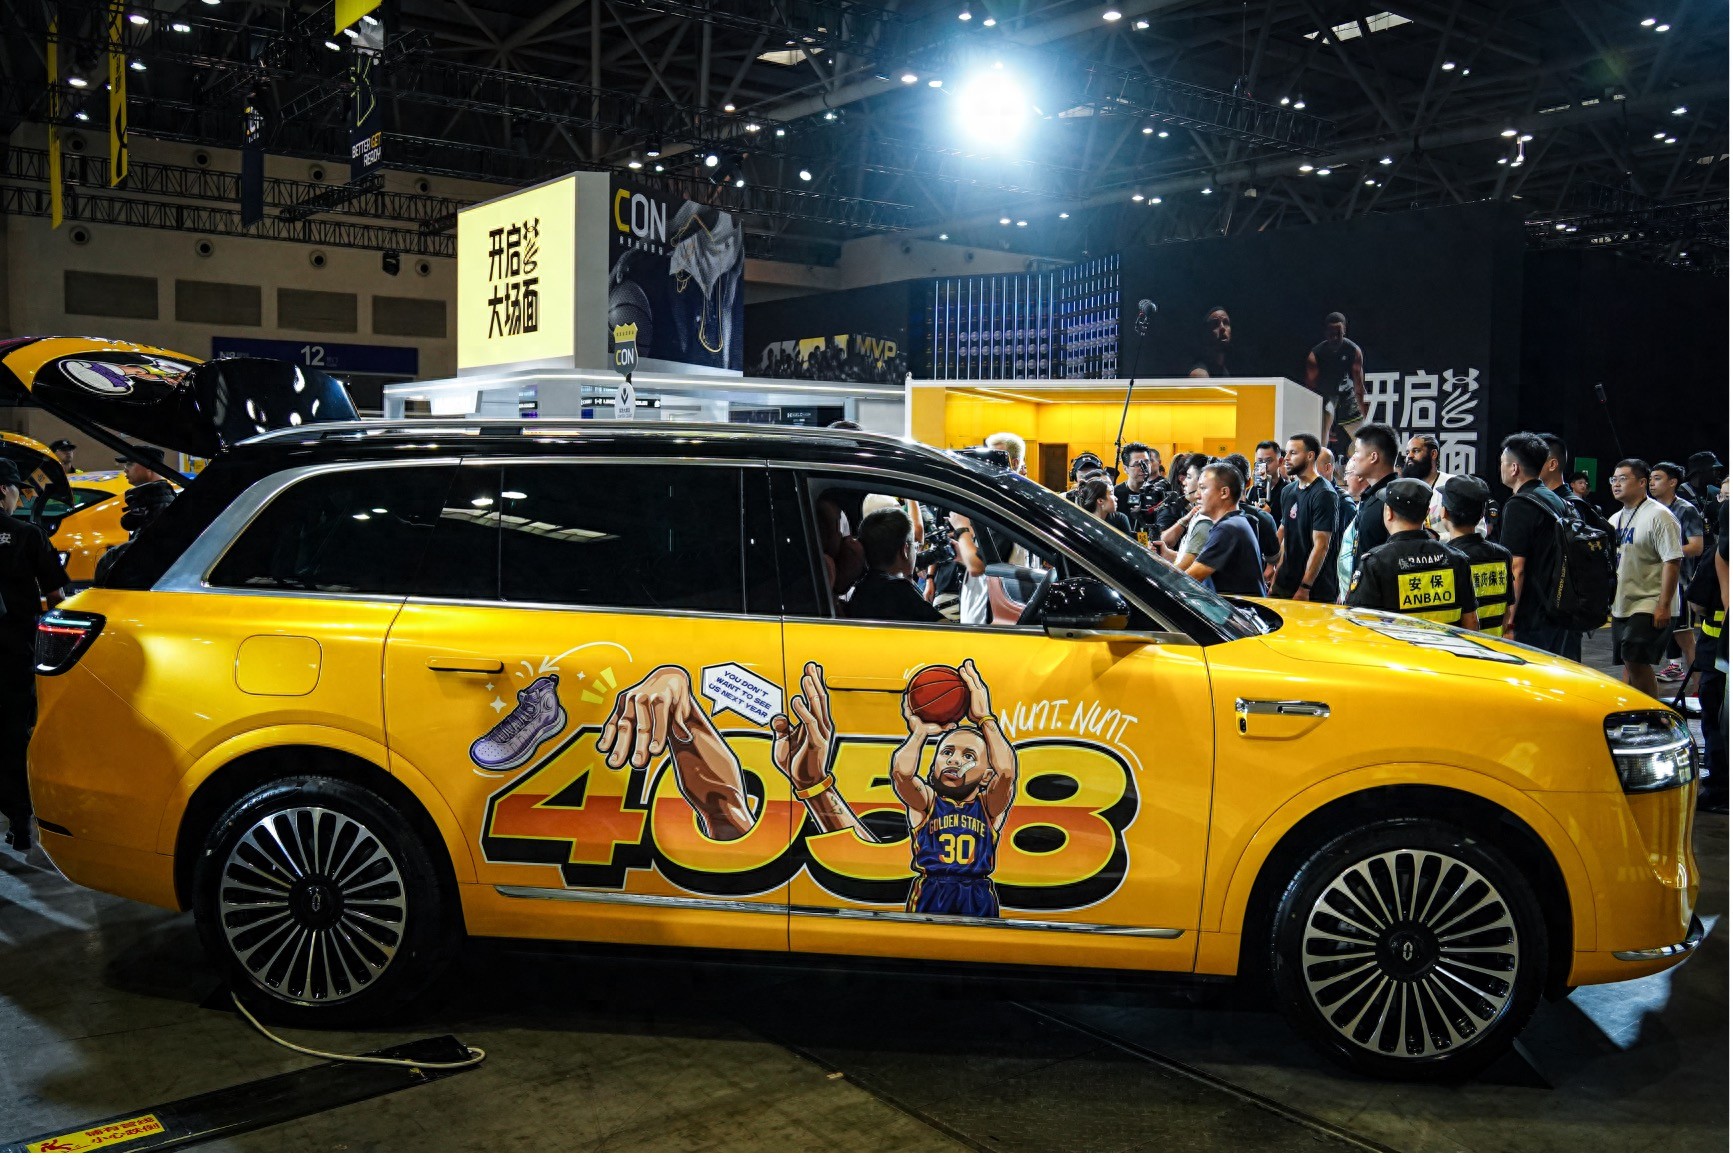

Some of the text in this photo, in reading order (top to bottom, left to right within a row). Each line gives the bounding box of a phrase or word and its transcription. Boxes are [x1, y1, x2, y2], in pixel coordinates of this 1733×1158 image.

[352, 131, 382, 159] BETTER GET
[364, 147, 381, 167] READY
[615, 188, 666, 243] CON
[489, 223, 521, 282] 开启
[488, 277, 539, 339] 大场面
[300, 345, 325, 366] 12
[615, 348, 634, 366] CON
[856, 334, 897, 361] MVP
[1363, 369, 1439, 428] 开启
[1408, 574, 1444, 591] 安保
[1403, 590, 1452, 606] ANBAO
[716, 677, 772, 710] WANT TO SEE
[724, 670, 769, 697] YOU DON'T
[708, 682, 768, 718] US NEXT YEAR
[482, 727, 1136, 900] 4058
[929, 814, 986, 837] GOLDEN STATE
[939, 833, 976, 864] 30
[92, 1123, 161, 1144] 小心跌倒
